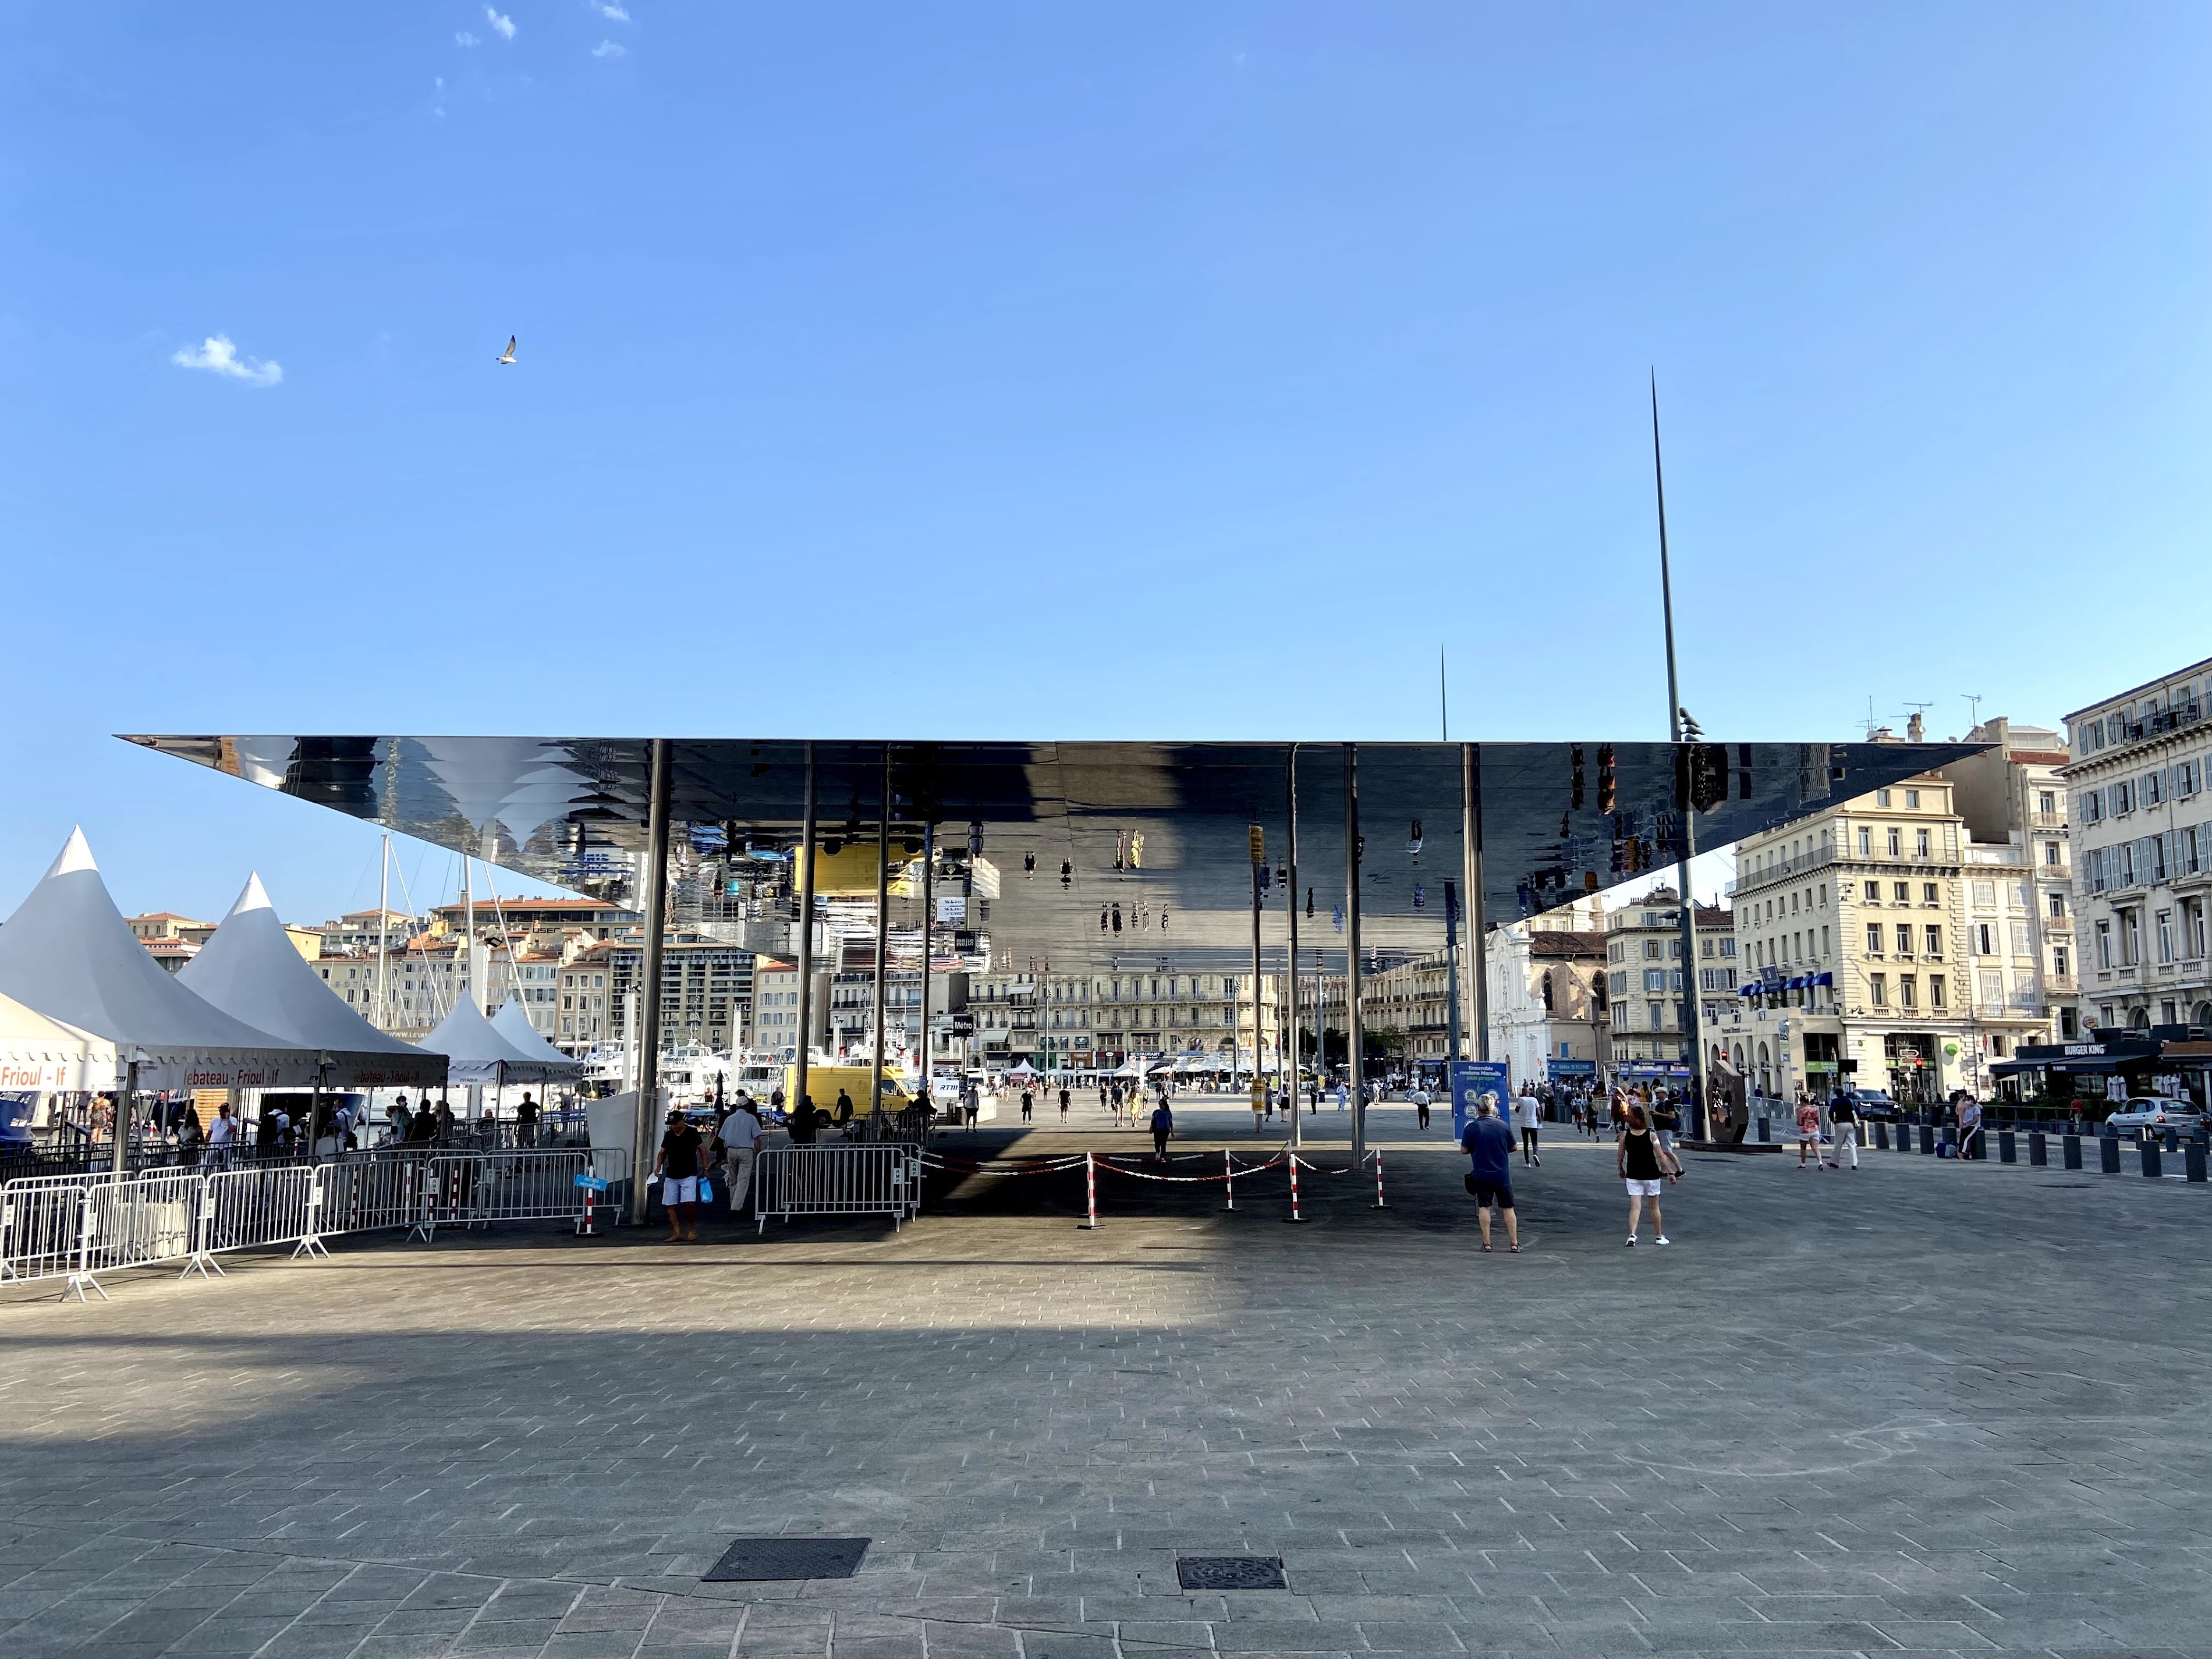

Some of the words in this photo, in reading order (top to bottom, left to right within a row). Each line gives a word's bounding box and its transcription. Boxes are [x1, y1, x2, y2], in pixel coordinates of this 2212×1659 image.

[955, 1021, 973, 1029] Métro
[2064, 1044, 2088, 1055] BURGER
[2089, 1044, 2105, 1055] KING
[1, 1066, 42, 1086] Frioul
[56, 1066, 66, 1086] If
[183, 1069, 228, 1085] lebateau
[237, 1069, 264, 1085] Frioul
[271, 1069, 279, 1084] If
